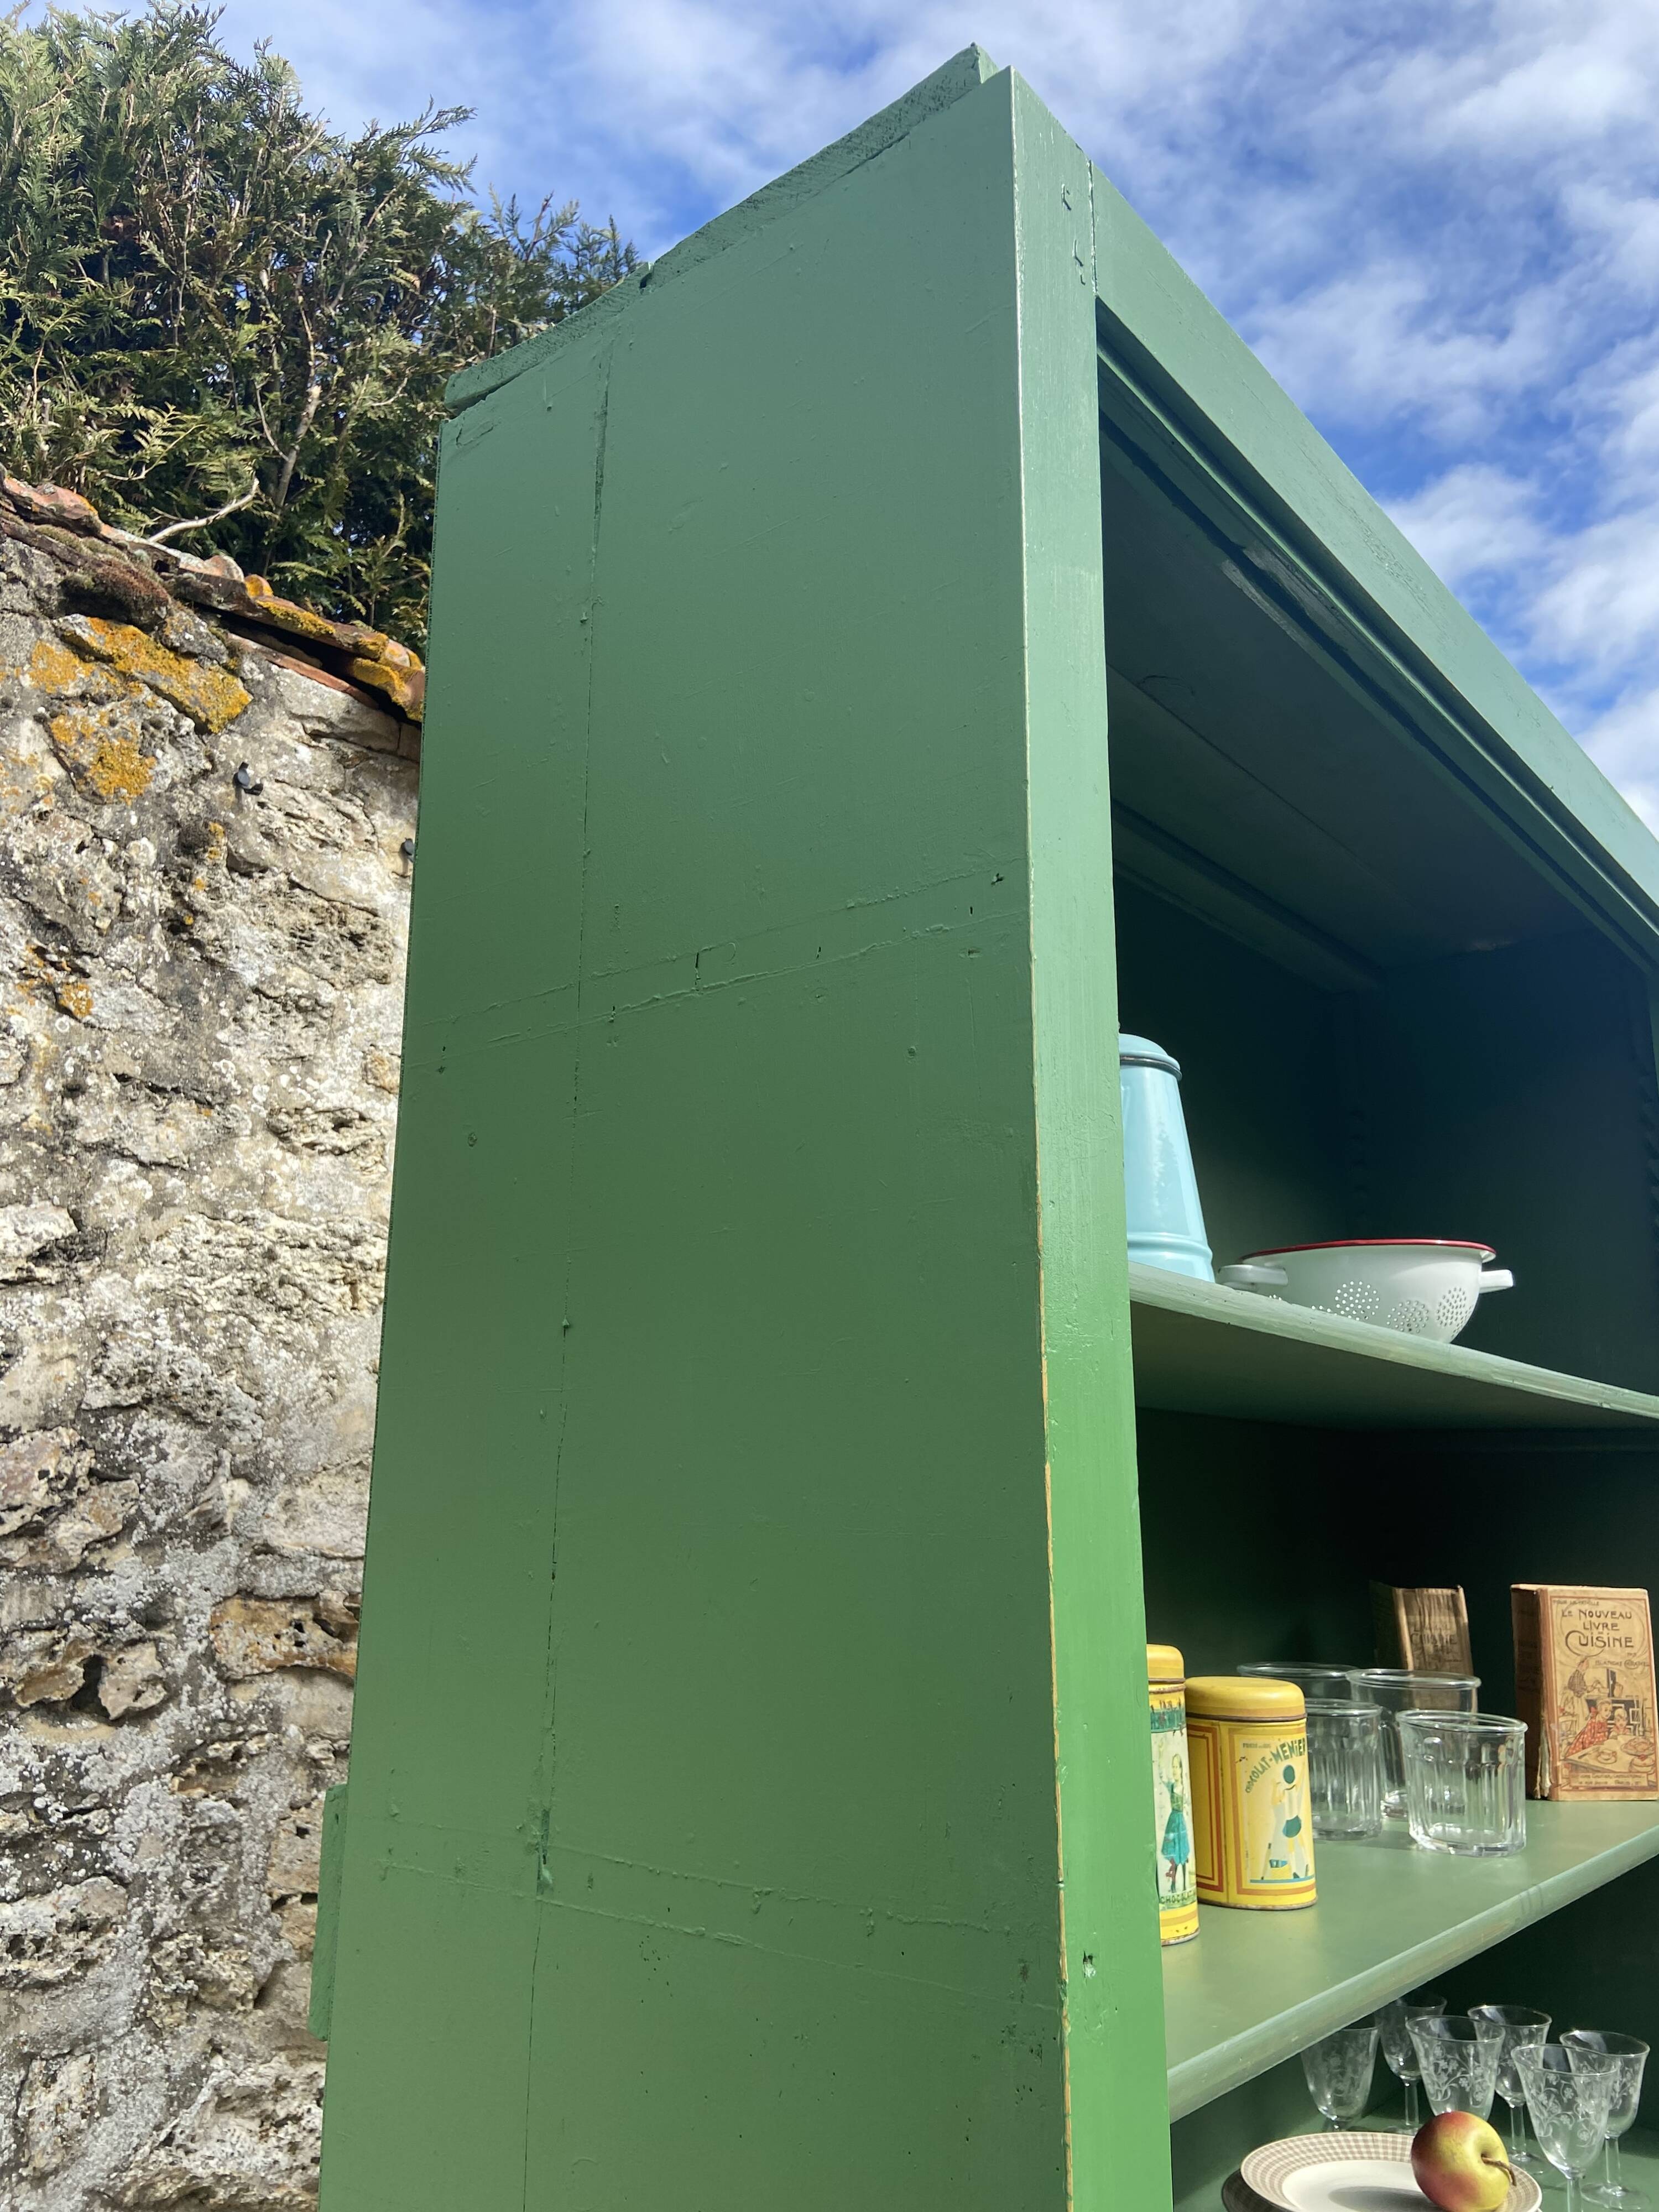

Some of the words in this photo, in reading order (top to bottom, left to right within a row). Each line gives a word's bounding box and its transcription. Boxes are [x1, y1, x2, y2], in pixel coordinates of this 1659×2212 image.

[1579, 1609, 1632, 1620] NOUVEAU
[1583, 1620, 1620, 1631] LIVRE
[1565, 1630, 1634, 1657] CUISINE
